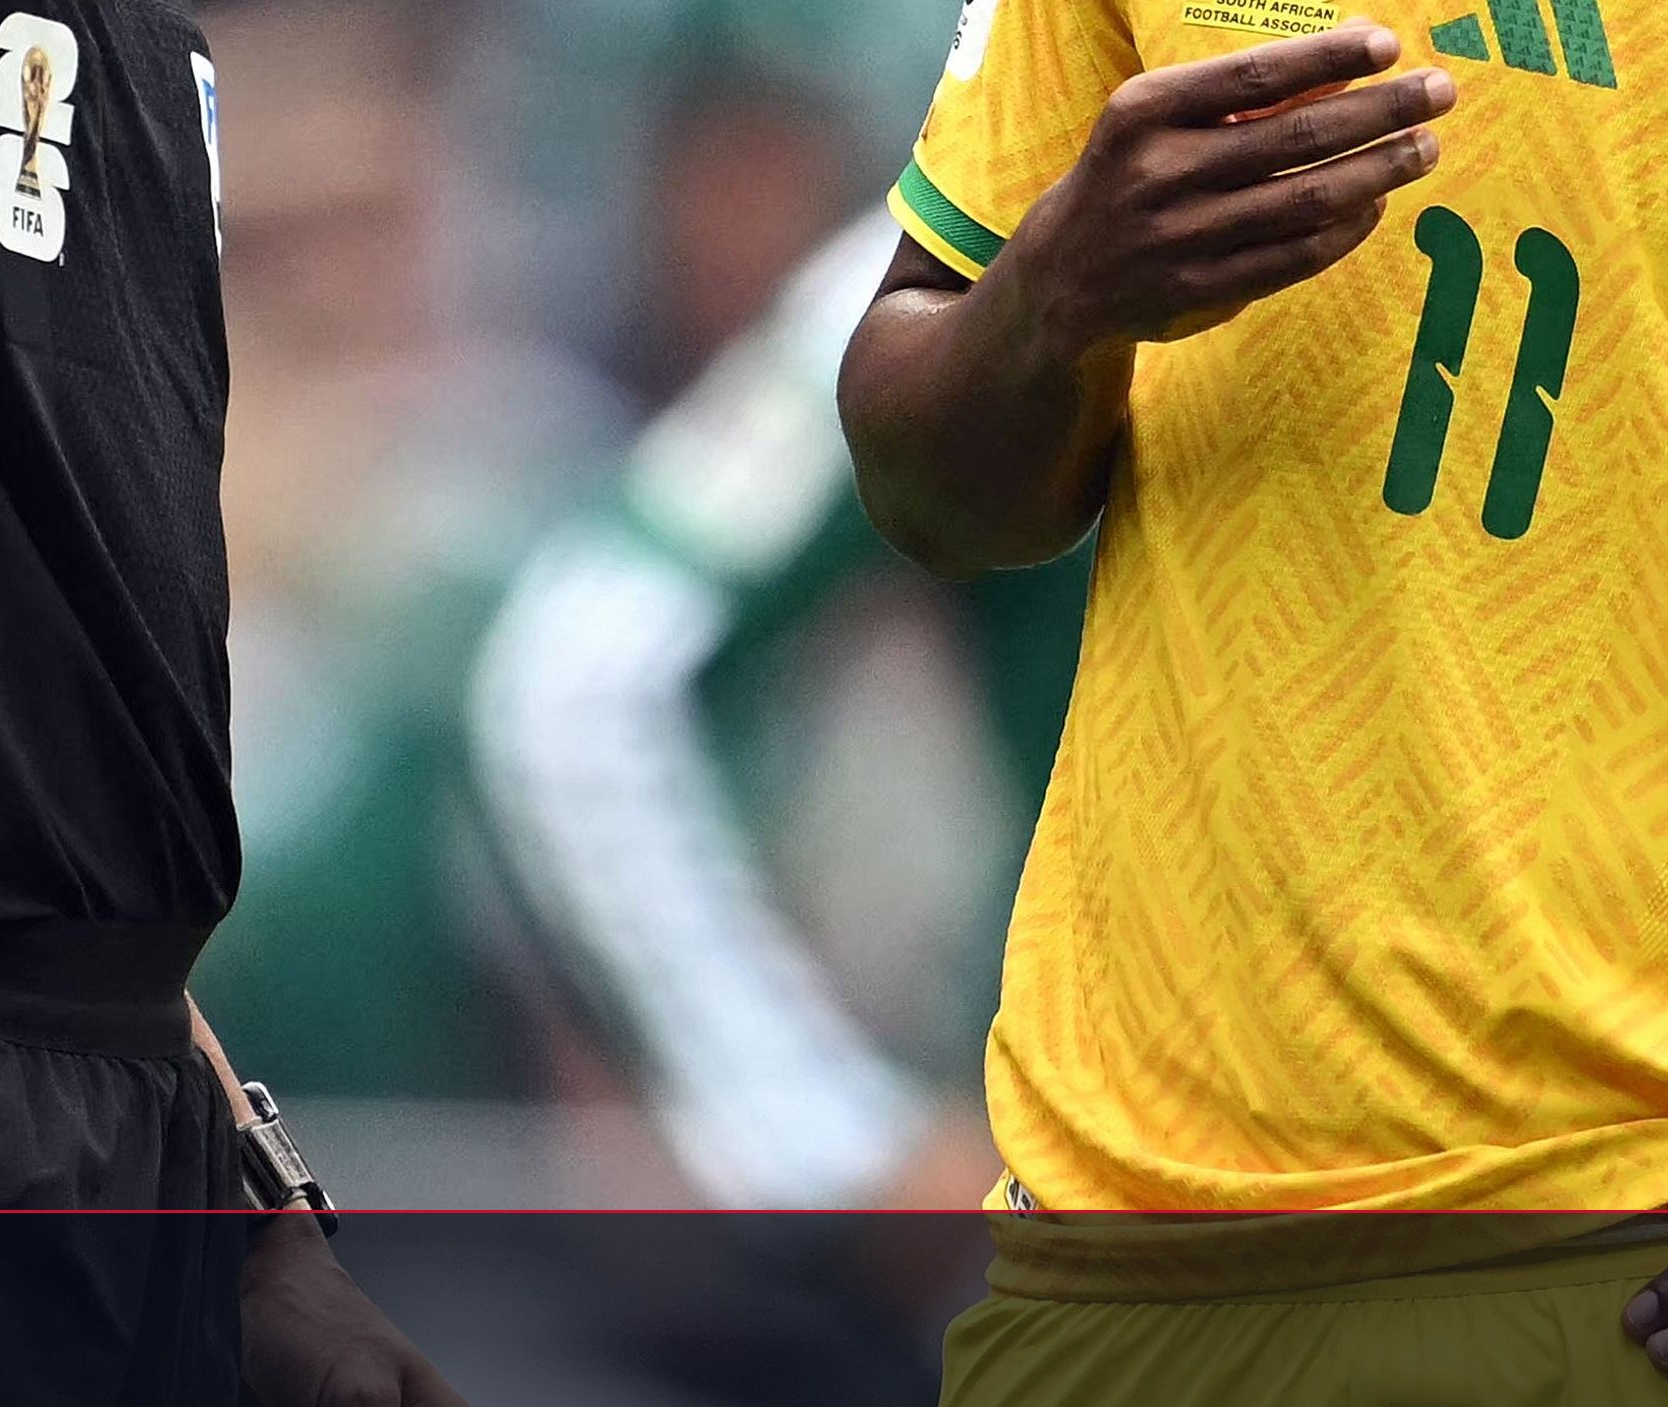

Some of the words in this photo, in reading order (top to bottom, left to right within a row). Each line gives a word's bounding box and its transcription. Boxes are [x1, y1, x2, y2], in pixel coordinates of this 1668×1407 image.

[1185, 7, 1255, 26] FOOTBALL
[1270, 1, 1335, 20] AFRICAN
[12, 206, 44, 237] FIFA
[1382, 205, 1580, 540] 11
